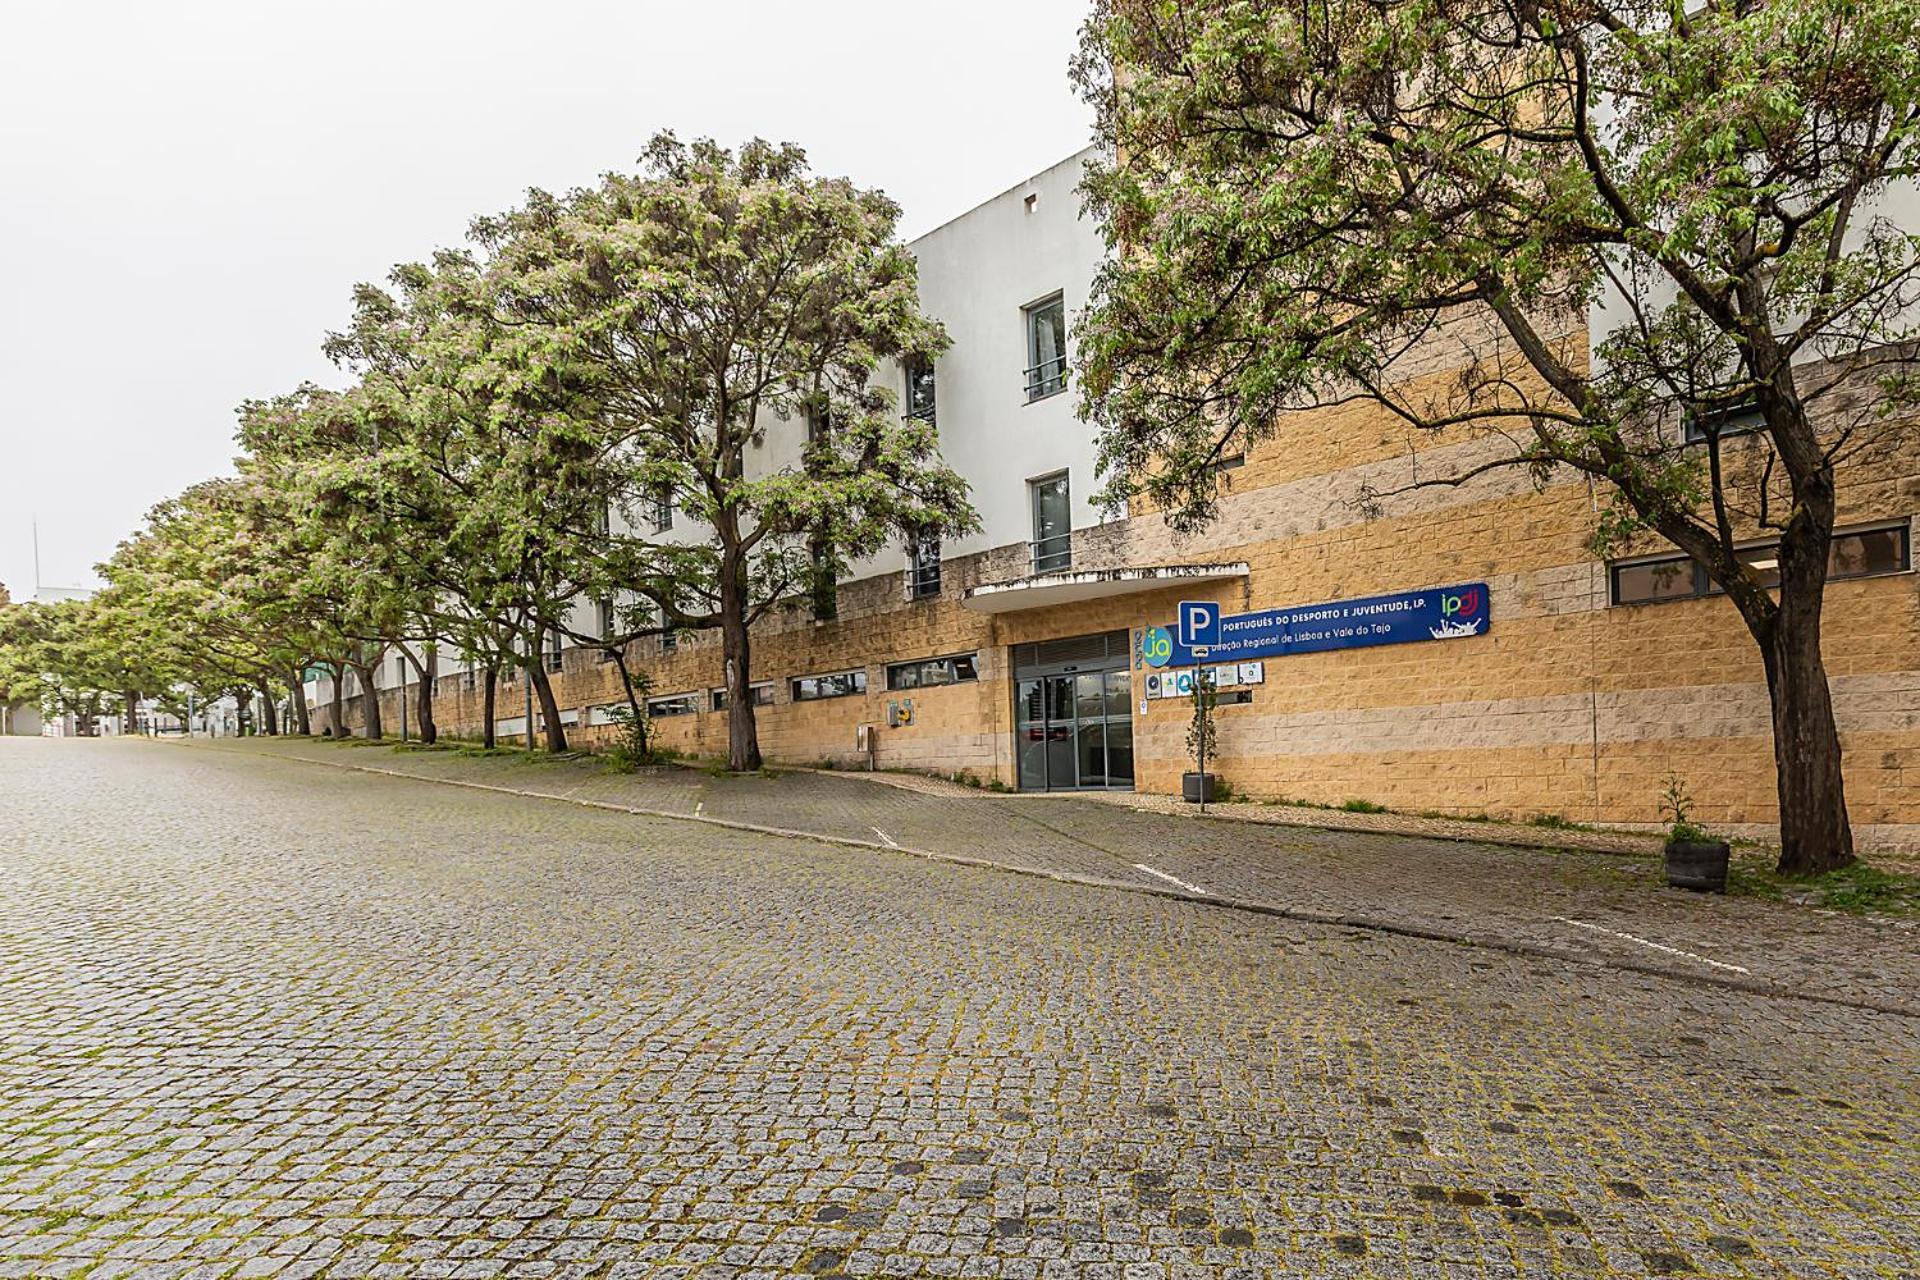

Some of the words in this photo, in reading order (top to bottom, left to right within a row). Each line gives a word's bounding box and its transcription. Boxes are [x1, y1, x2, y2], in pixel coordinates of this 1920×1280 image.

[1189, 607, 1211, 641] P
[1222, 616, 1273, 632] PORTUGUÊS
[1275, 617, 1290, 625] DO
[1292, 609, 1340, 622] DESPORTO
[1343, 609, 1349, 617] E
[1351, 602, 1412, 617] JUVENTUDE,
[1243, 637, 1280, 649] Regional
[1281, 634, 1293, 643] de
[1294, 630, 1323, 641] Lisboa
[1332, 628, 1354, 638] Vale
[1356, 625, 1369, 634] do
[1371, 623, 1391, 634] Tejo
